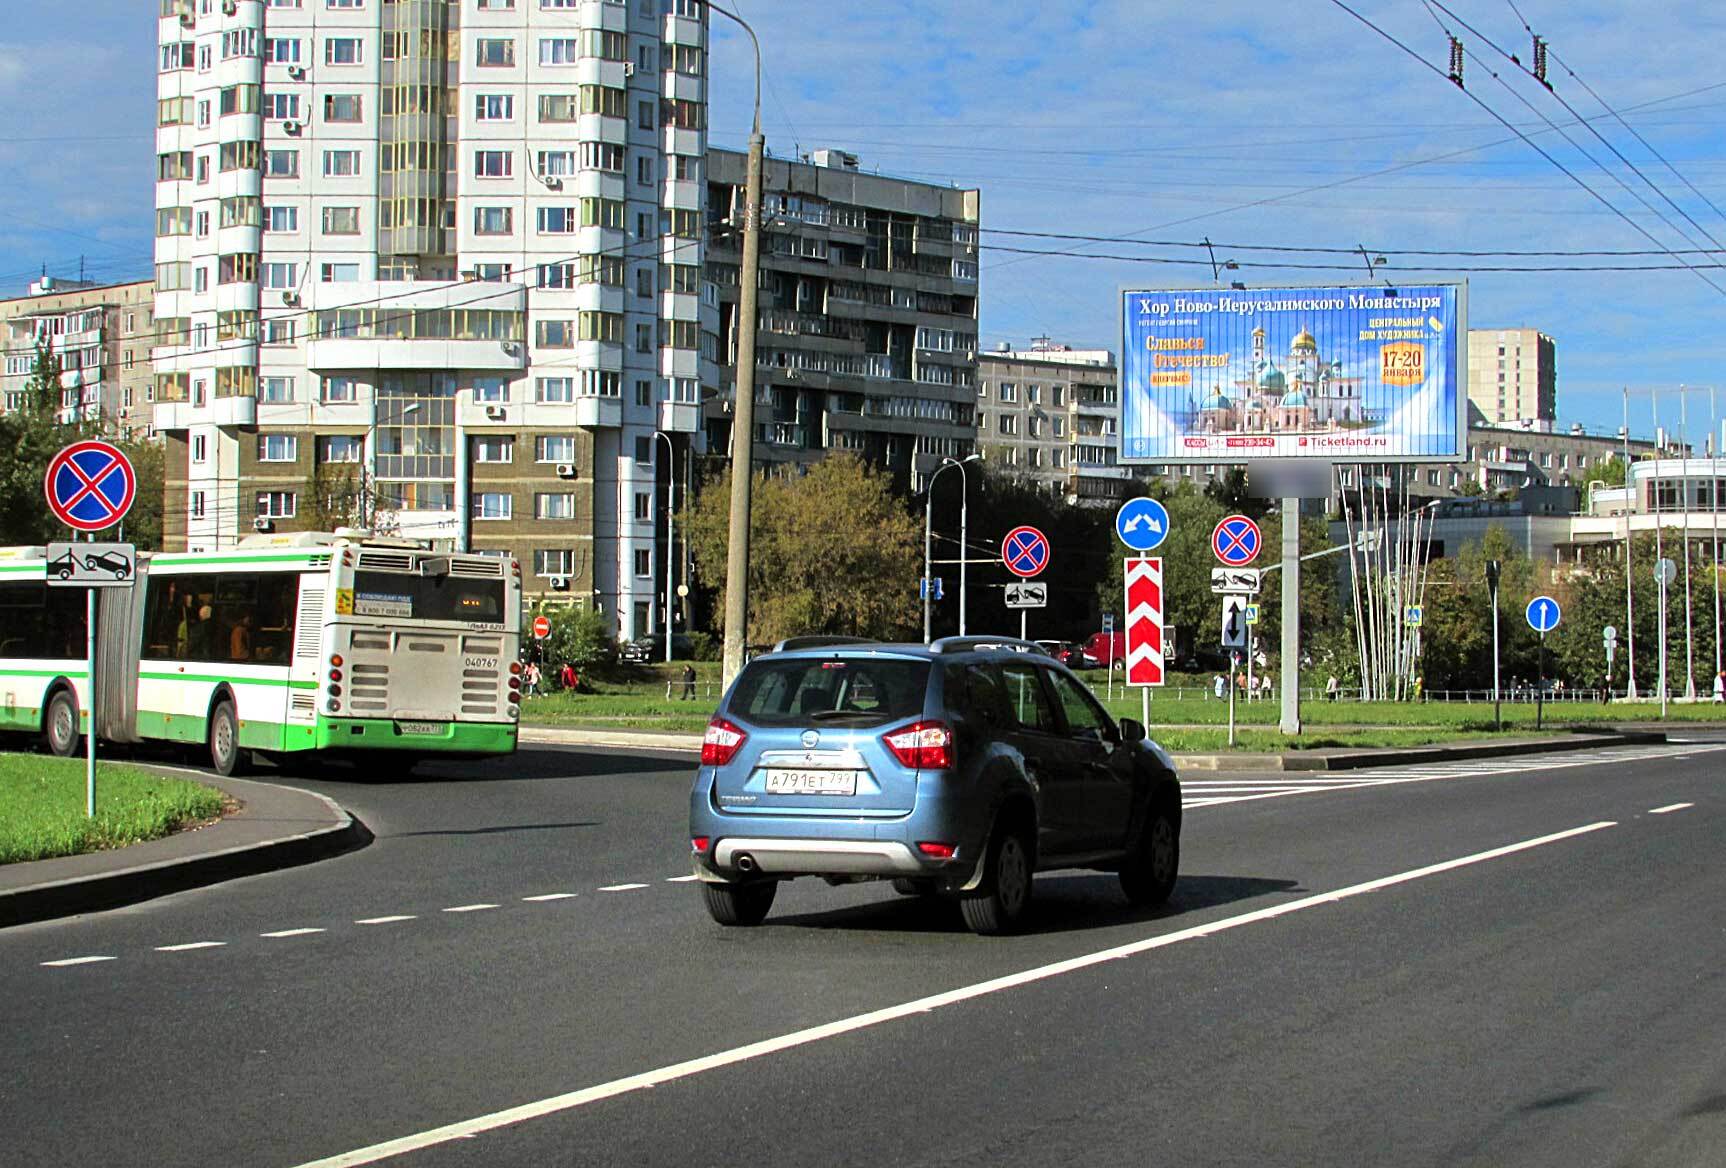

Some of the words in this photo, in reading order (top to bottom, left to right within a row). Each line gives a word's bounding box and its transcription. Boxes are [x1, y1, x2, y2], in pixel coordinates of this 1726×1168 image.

[1139, 298, 1170, 318] Хор
[1174, 296, 1345, 316] Ново-Иерусалимского
[1348, 294, 1441, 312] Монастыря
[1369, 316, 1424, 328] ЦЕНТРАЛЬНЫЙ
[1359, 330, 1376, 341] ДОМ
[1377, 329, 1424, 340] ХУДОЖНИКА
[1383, 351, 1421, 367] 17-20
[1383, 368, 1421, 378] января
[1310, 437, 1387, 448] Ticketland.ru
[465, 657, 498, 668] 040767
